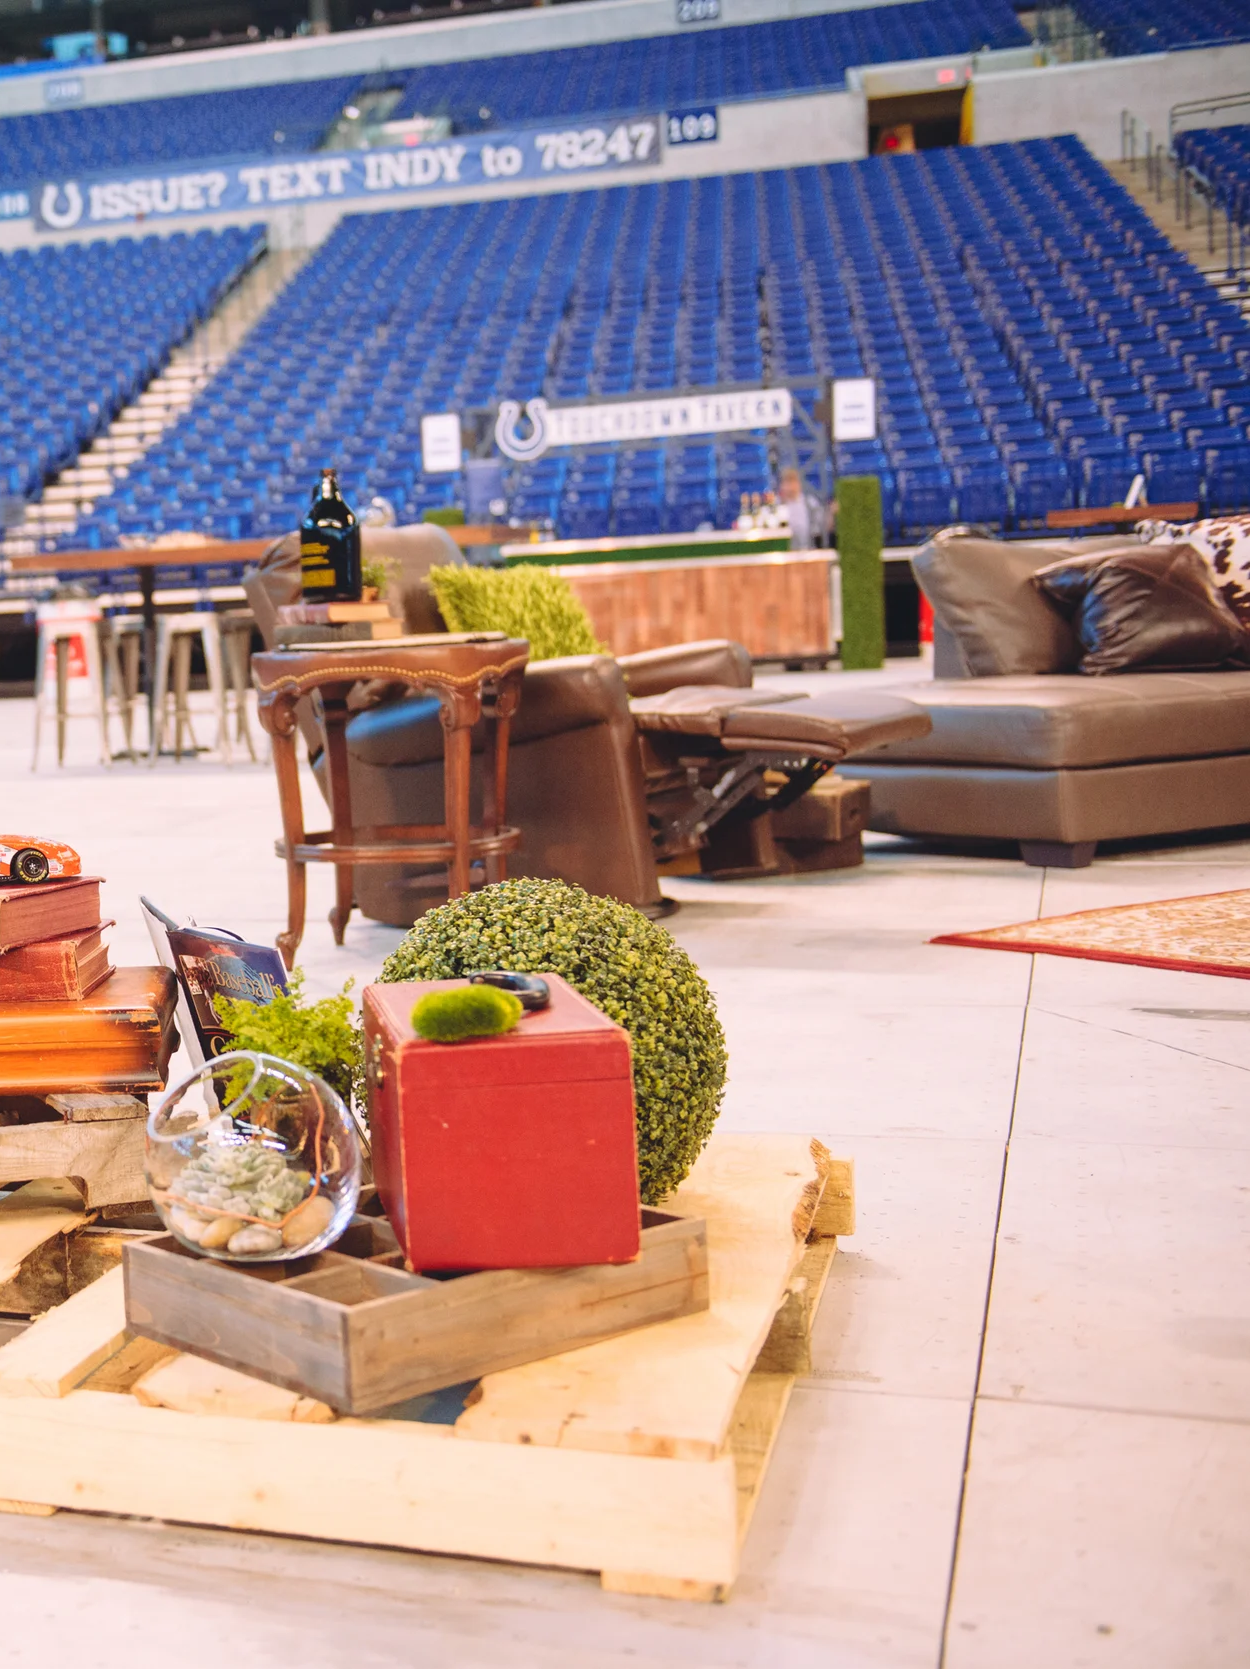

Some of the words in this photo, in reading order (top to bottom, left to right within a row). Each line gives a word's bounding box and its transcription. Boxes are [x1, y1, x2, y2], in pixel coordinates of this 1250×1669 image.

[666, 113, 717, 143] 109
[88, 172, 228, 221] ISSUE?
[238, 157, 350, 203] TEXT
[363, 144, 467, 191] INDY
[480, 144, 523, 178] to
[534, 122, 655, 170] 78247
[553, 407, 691, 440] TOUCHDOWN
[699, 397, 783, 426] TAVERN
